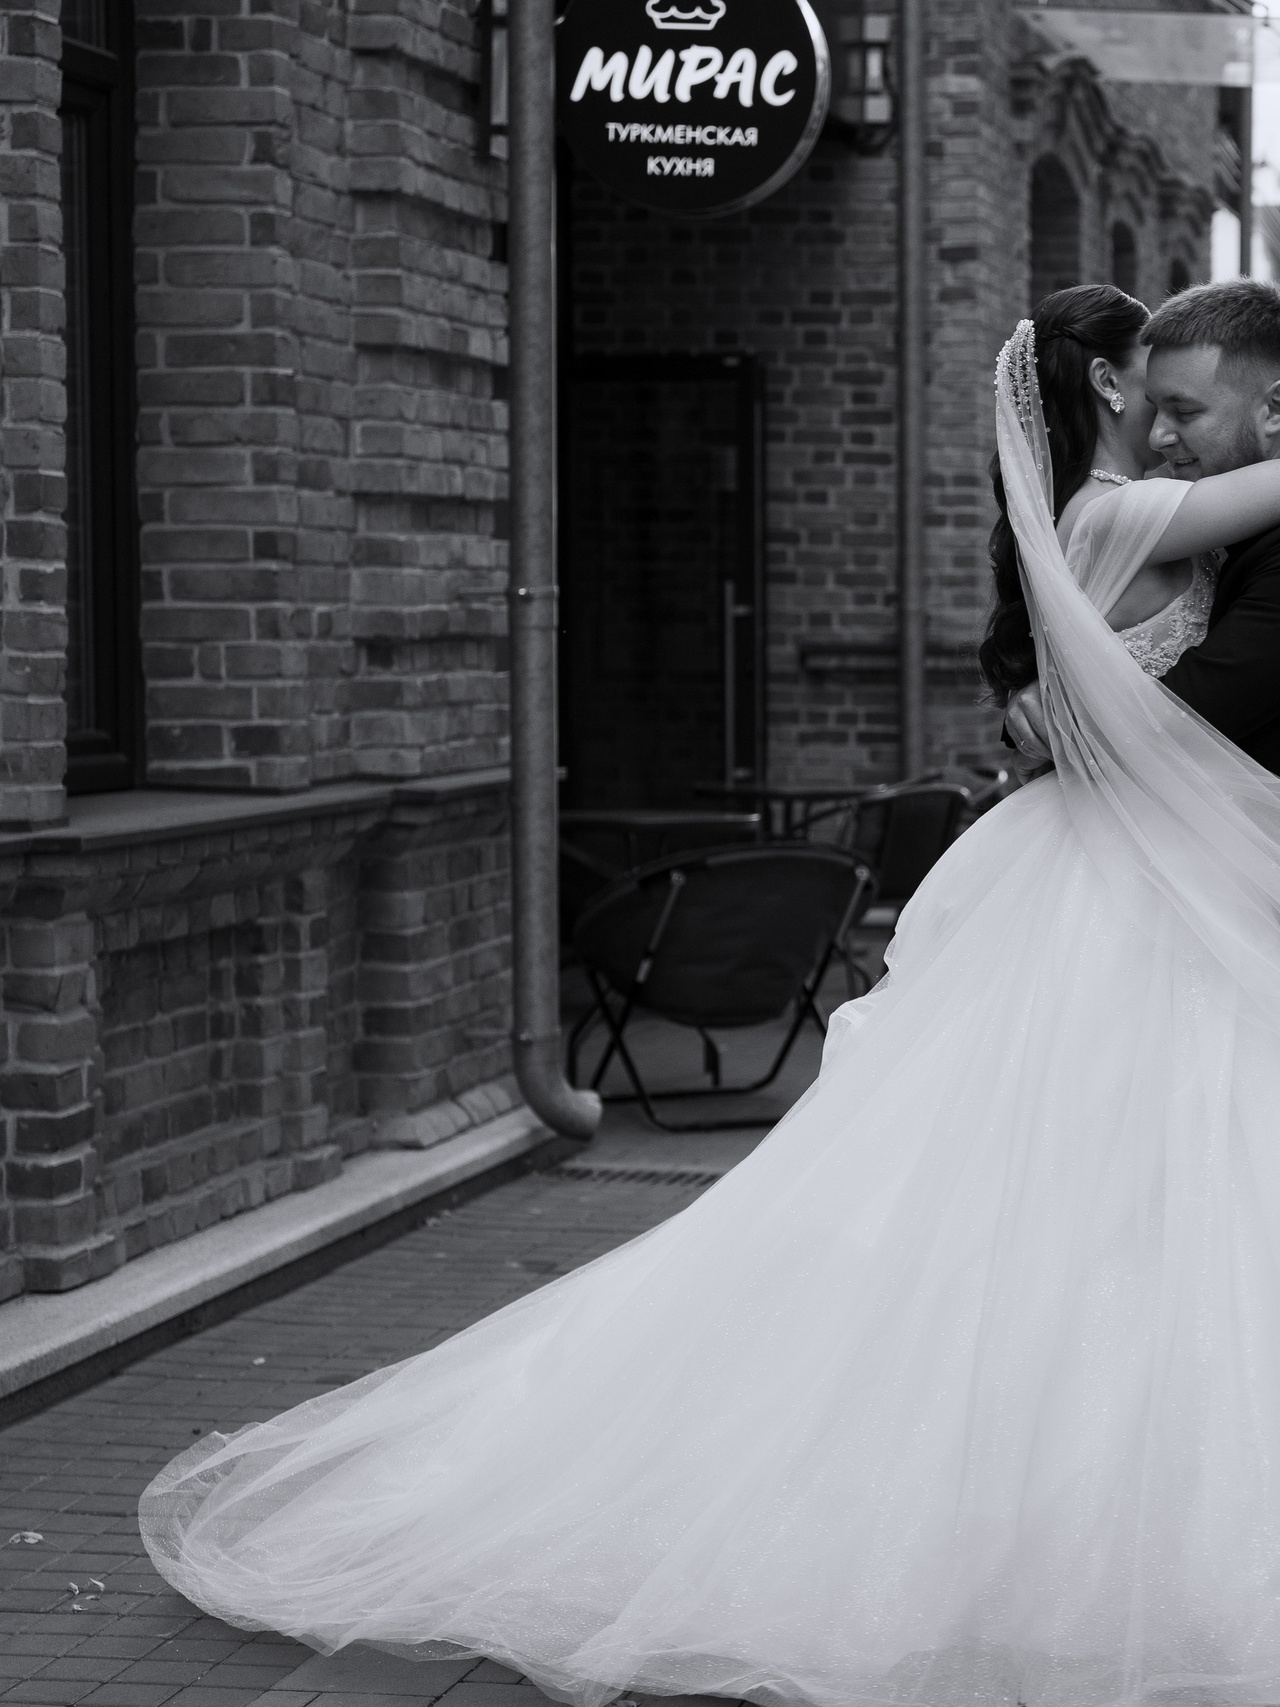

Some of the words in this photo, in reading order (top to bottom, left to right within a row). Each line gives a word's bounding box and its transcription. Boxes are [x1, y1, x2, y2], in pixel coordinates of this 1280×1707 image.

[569, 44, 798, 107] МИРАС
[605, 122, 758, 146] ТУРКМЕНСКАЯ
[647, 156, 715, 177] КУХНЯ
